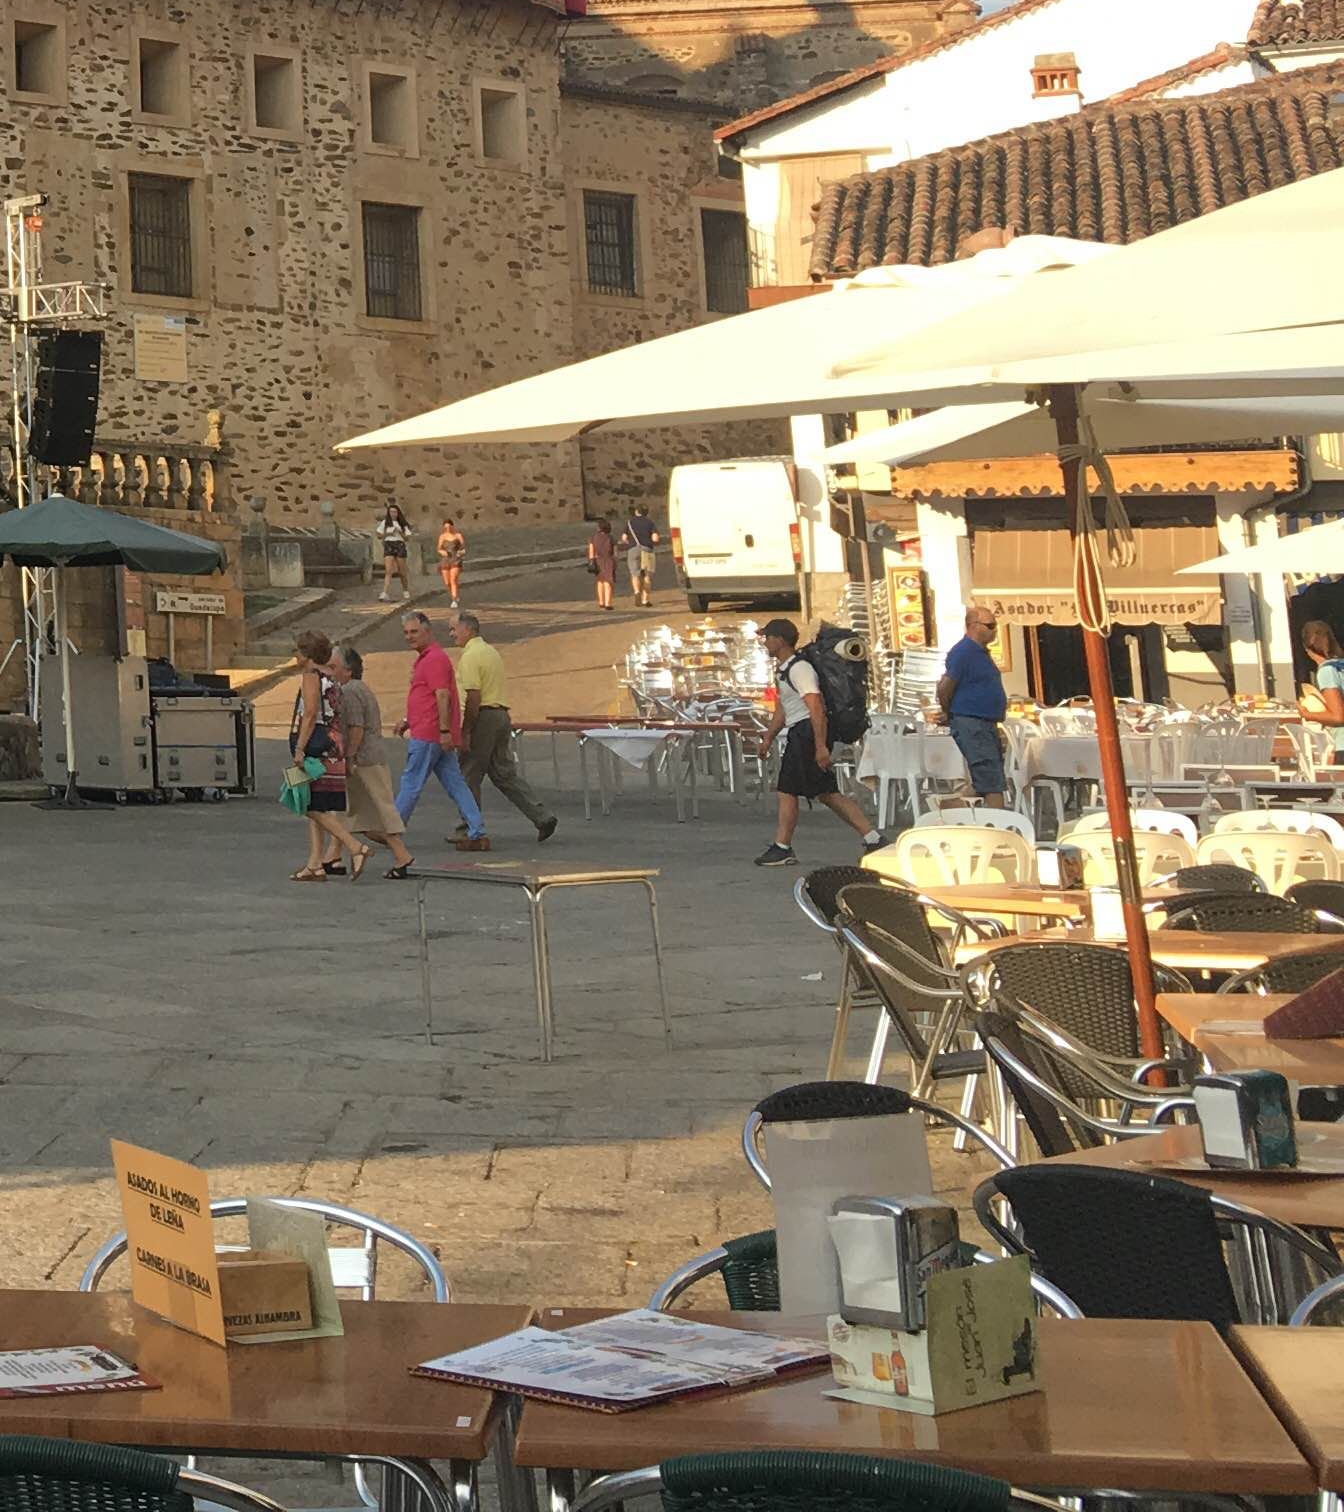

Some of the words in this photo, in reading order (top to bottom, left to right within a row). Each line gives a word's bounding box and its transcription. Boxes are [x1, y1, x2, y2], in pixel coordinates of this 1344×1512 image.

[993, 599, 1055, 616] Asador
[127, 1171, 158, 1197] ASADOS
[159, 1184, 170, 1202] AL
[171, 1190, 201, 1213] HORNO
[150, 1203, 162, 1221] DE
[162, 1207, 185, 1230] LEÑA
[136, 1247, 166, 1273] CARNES
[167, 1263, 175, 1276] A
[175, 1267, 187, 1283] LA
[186, 1269, 212, 1295] BRASA
[255, 1310, 302, 1326] ALHAMBRA
